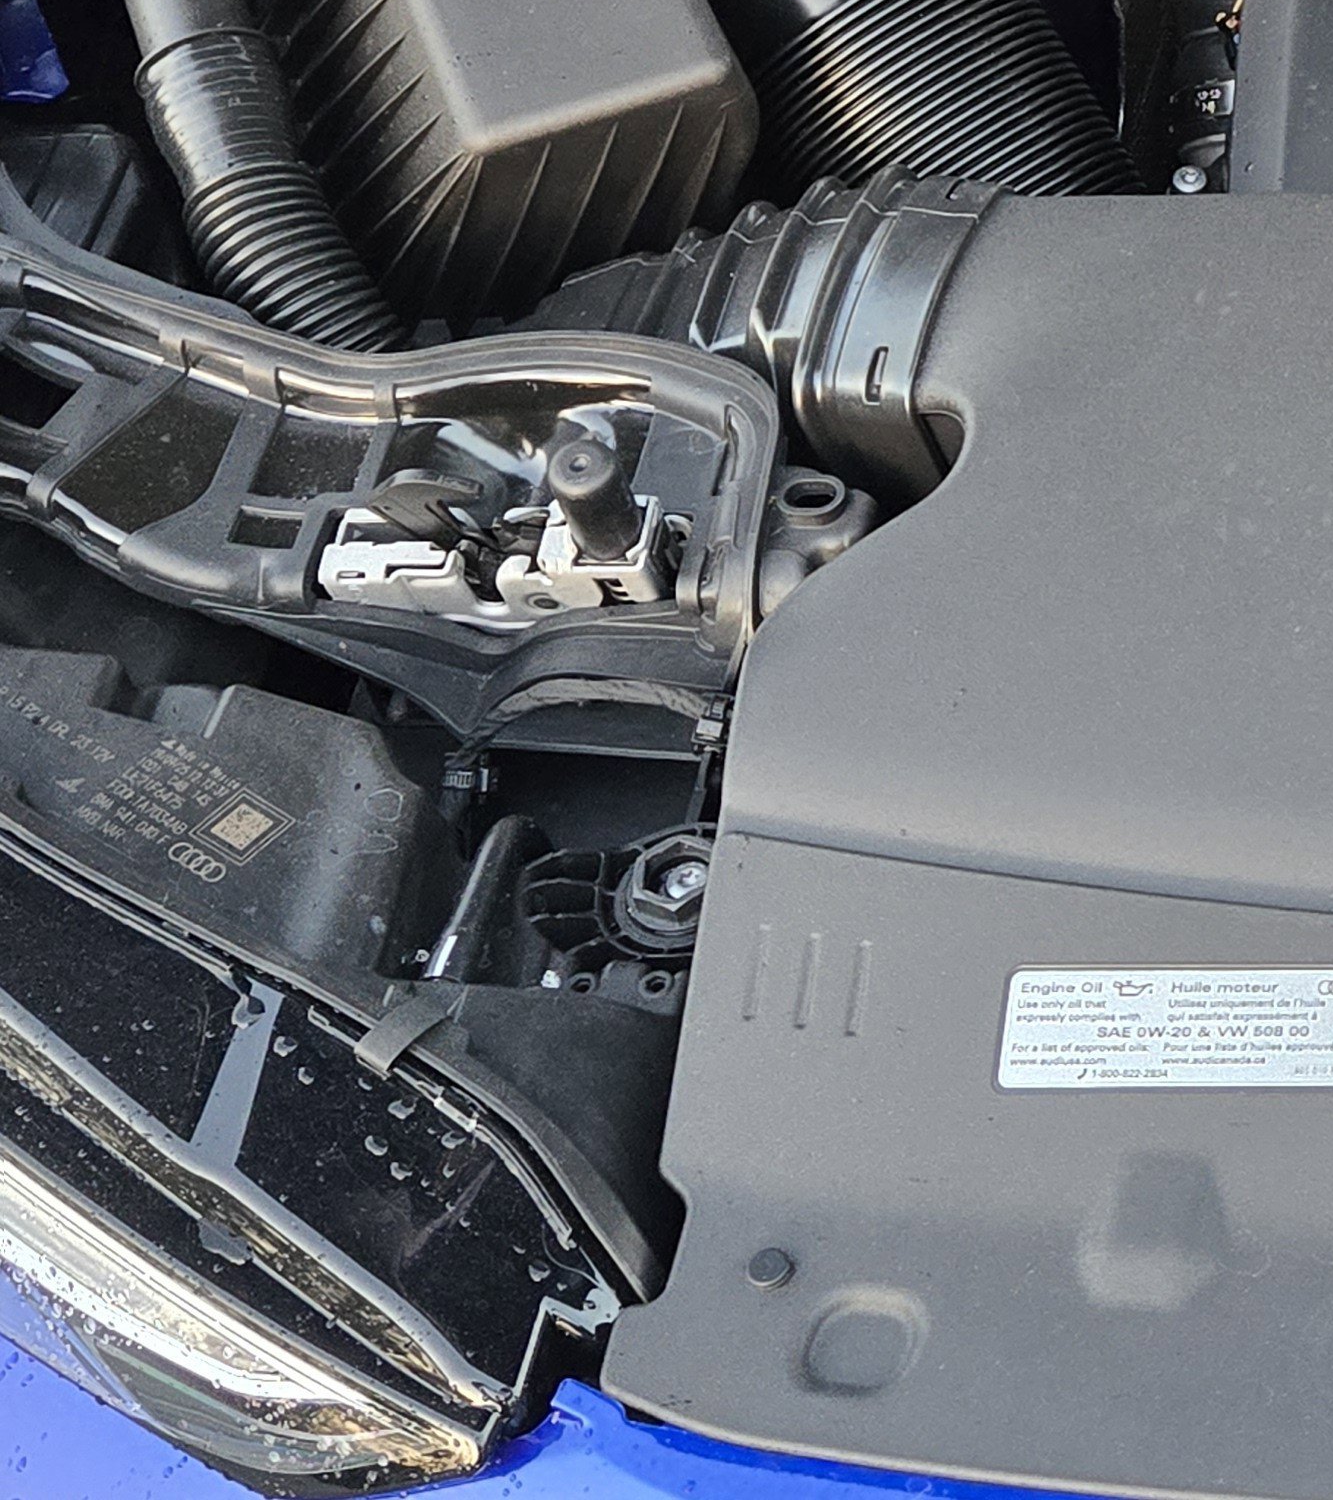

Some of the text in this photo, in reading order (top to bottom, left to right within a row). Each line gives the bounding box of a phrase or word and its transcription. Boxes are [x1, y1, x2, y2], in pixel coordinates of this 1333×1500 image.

[1021, 982, 1103, 995] Engine Oil
[1171, 982, 1279, 993] Huile moteur
[1017, 999, 1107, 1009] Use only oil that
[1168, 999, 1326, 1009] Utilisez uniquement de l'huile
[1016, 1014, 1066, 1023] expressly
[1068, 1014, 1116, 1023] complies
[1167, 1013, 1184, 1023] qui
[1232, 1013, 1308, 1022] expressément
[1096, 1026, 1310, 1038] SAE 0W-20 & VW 508 00
[1011, 1043, 1030, 1052] For
[1042, 1043, 1058, 1052] list
[1060, 1043, 1072, 1052] of
[1074, 1043, 1125, 1053] approved
[1163, 1043, 1188, 1052] Pour
[1191, 1043, 1211, 1051] une
[1214, 1042, 1237, 1051] liste
[1009, 1057, 1107, 1065] www.audiusa.com
[1162, 1056, 1266, 1065] www.audicanada.ca
